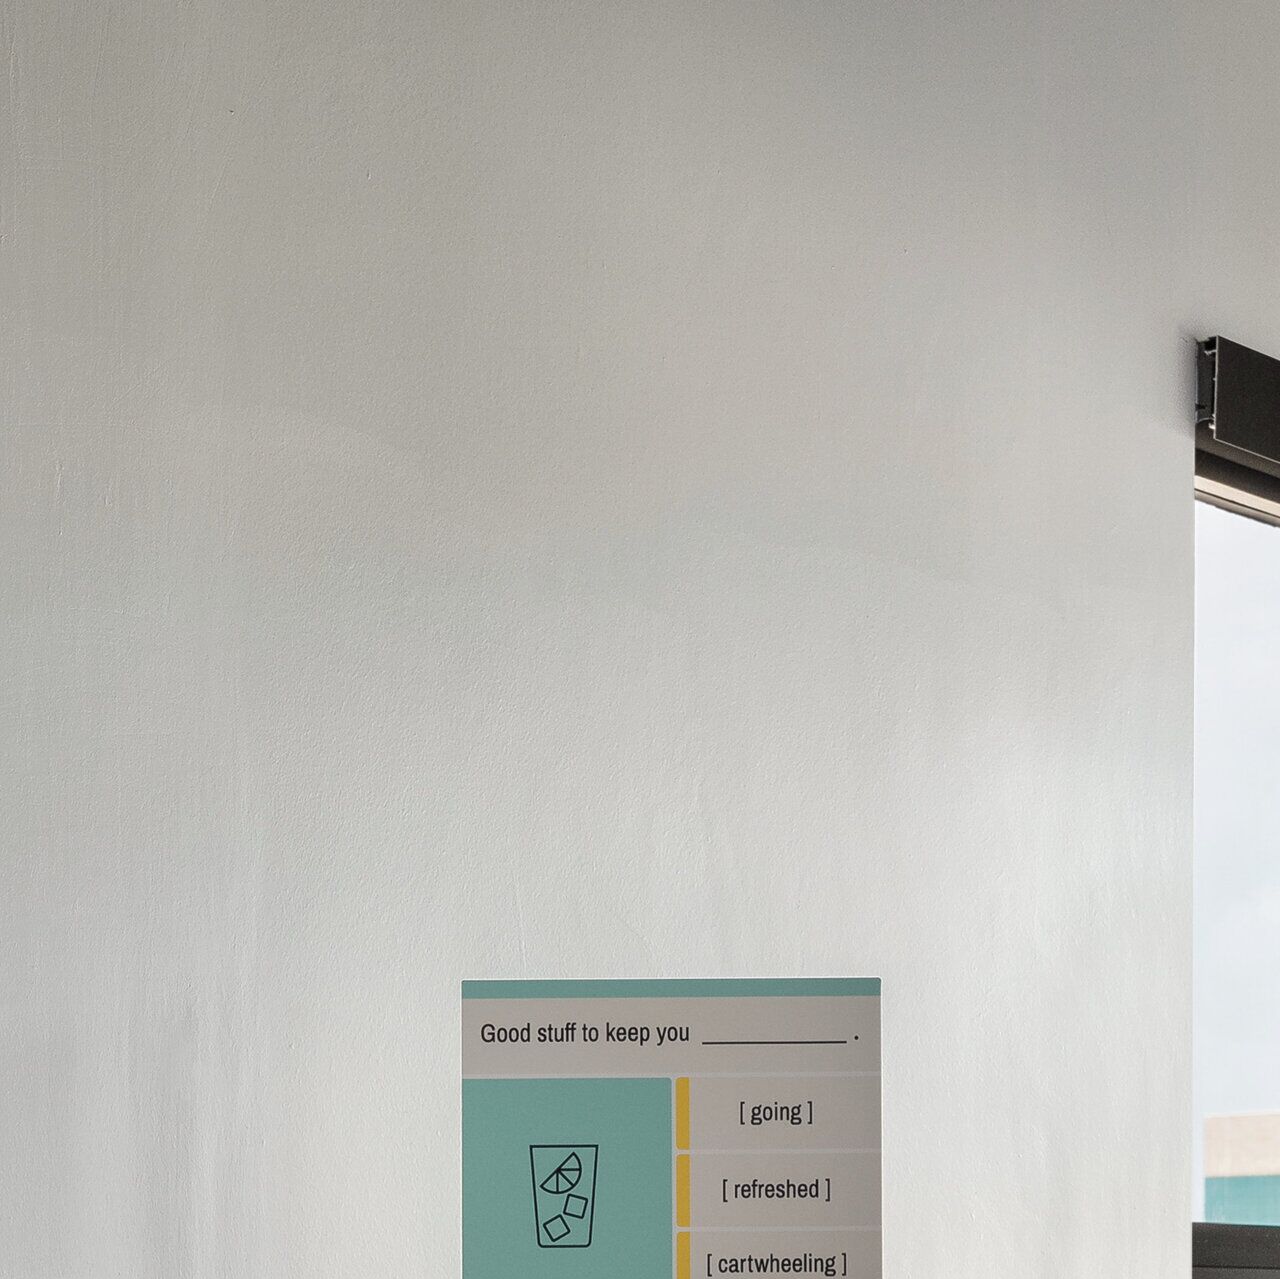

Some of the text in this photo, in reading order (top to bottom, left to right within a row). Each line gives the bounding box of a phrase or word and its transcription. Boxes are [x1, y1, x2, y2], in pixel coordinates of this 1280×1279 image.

[480, 1022, 531, 1044] Good
[537, 1022, 576, 1043] stuff
[581, 1023, 599, 1043] to
[605, 1021, 650, 1046] keep
[656, 1025, 690, 1047] you
[750, 1101, 803, 1126] going
[734, 1179, 819, 1199] refreshed
[718, 1253, 837, 1277] cartwheeling
